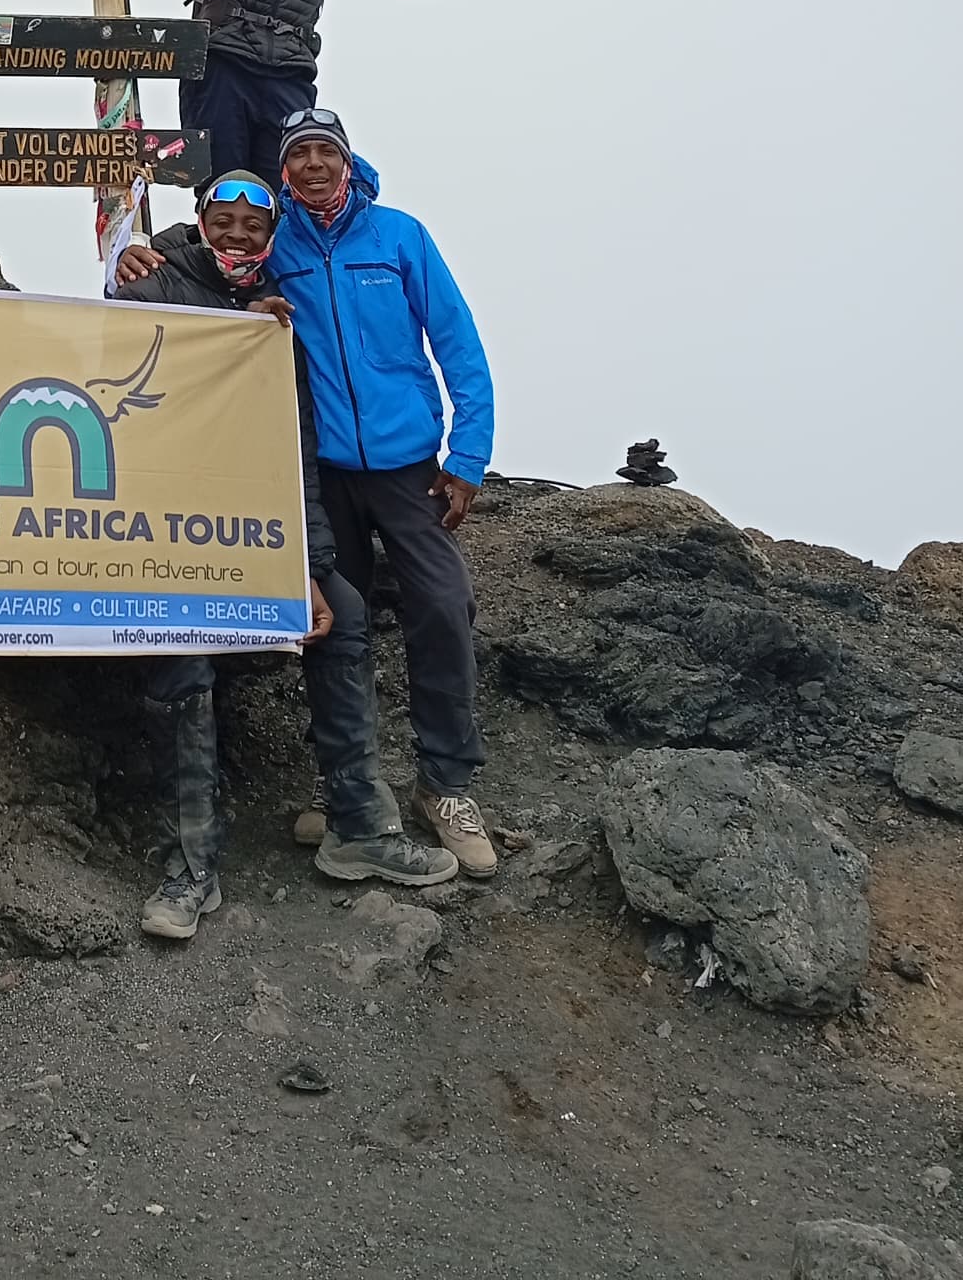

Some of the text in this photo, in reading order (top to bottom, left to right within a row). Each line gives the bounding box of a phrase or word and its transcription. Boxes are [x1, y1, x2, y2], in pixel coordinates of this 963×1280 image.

[75, 48, 174, 72] MOUNTAIN
[14, 131, 138, 157] VOLCANOES
[53, 160, 79, 183] OF
[12, 506, 154, 542] AFRICA
[164, 513, 285, 549] TOURS
[33, 560, 48, 577] a
[57, 557, 99, 580] tour,
[105, 562, 134, 578] an
[141, 558, 244, 583] Adventure
[90, 598, 169, 618] CULTURE
[205, 601, 279, 622] BEACHES
